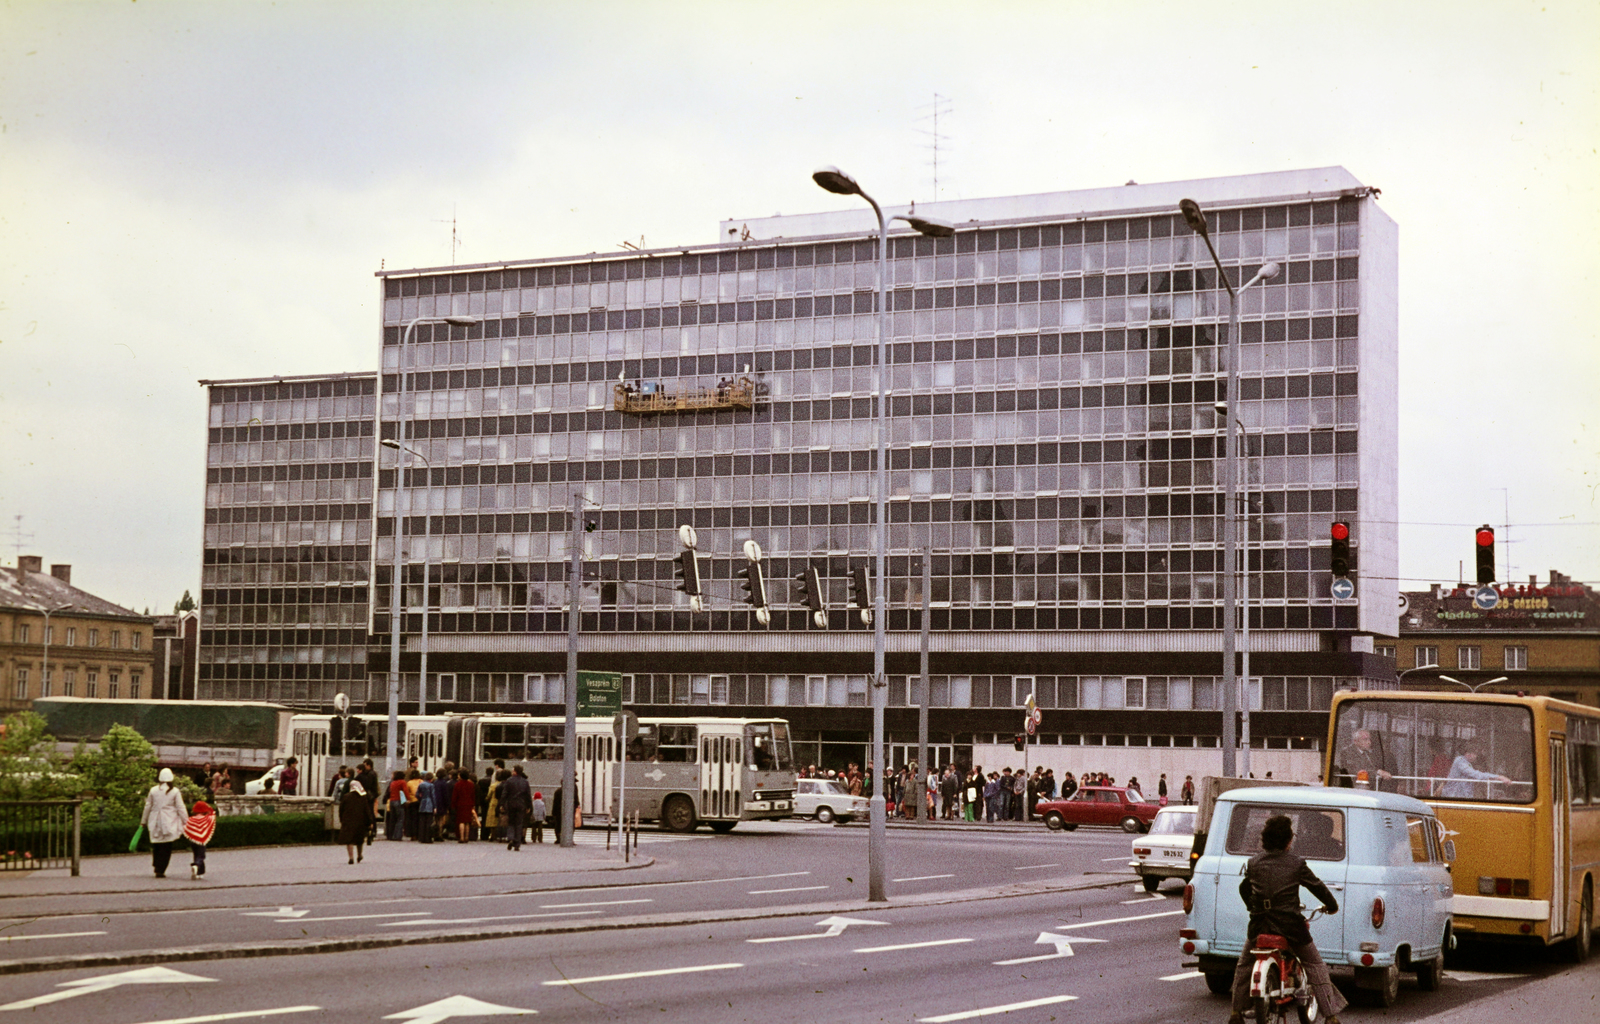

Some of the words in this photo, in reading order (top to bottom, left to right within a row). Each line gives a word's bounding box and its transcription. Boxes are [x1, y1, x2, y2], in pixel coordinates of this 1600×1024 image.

[1437, 585, 1585, 600] proetheus
[586, 678, 610, 688] Veszprém
[589, 694, 607, 702] Balaton
